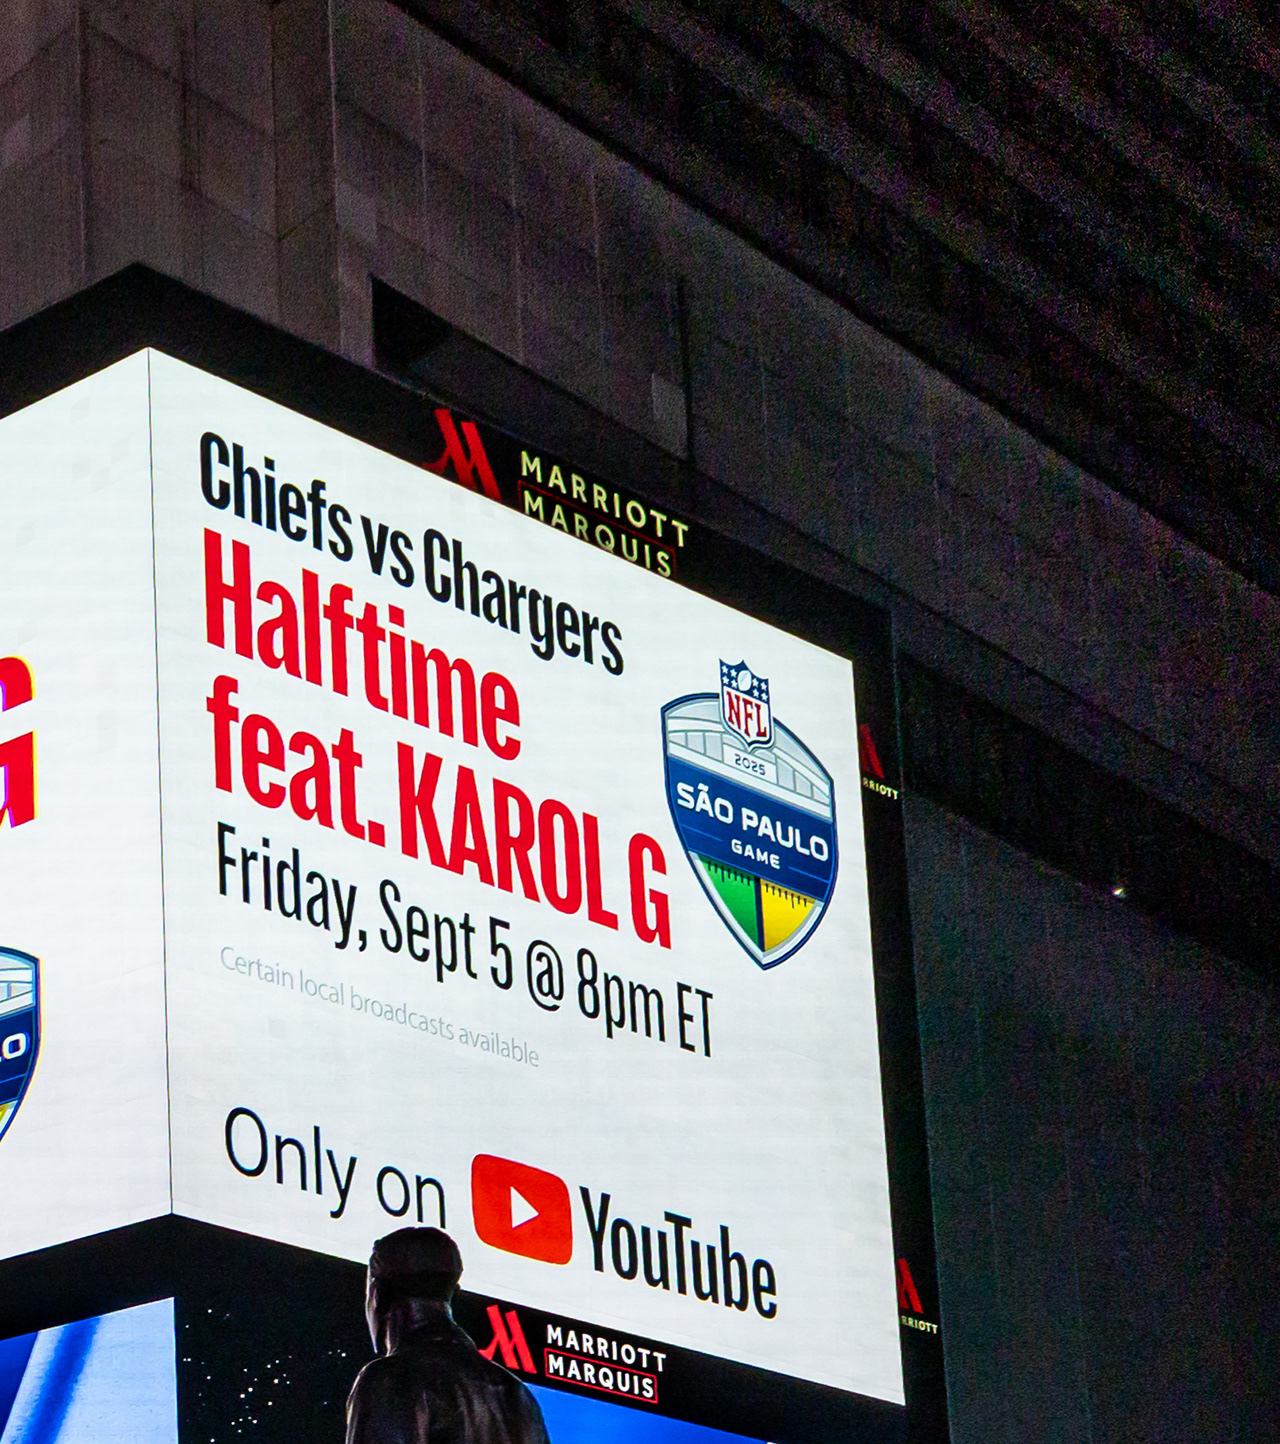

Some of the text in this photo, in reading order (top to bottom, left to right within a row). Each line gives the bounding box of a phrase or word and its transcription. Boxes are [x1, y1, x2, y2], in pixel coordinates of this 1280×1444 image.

[521, 451, 688, 547] MARRIOTT
[523, 490, 671, 577] MARQUIS
[200, 431, 625, 676] Chiefs vs Chargers
[203, 528, 521, 761] Halftime
[726, 690, 768, 738] NFL
[206, 674, 672, 950] feat. KAROL G
[734, 753, 766, 776] 2025
[676, 782, 829, 861] SÃO PAULO
[731, 839, 780, 869] GAME
[217, 820, 714, 1058] Friday, Sept 5 @ 8pm ET
[220, 946, 540, 1068] Certain local broadcasts available
[224, 1106, 446, 1228] Only on
[579, 1185, 778, 1319] YouTube
[546, 1323, 667, 1373] MARRIOTT
[548, 1354, 654, 1398] MARQUIS
